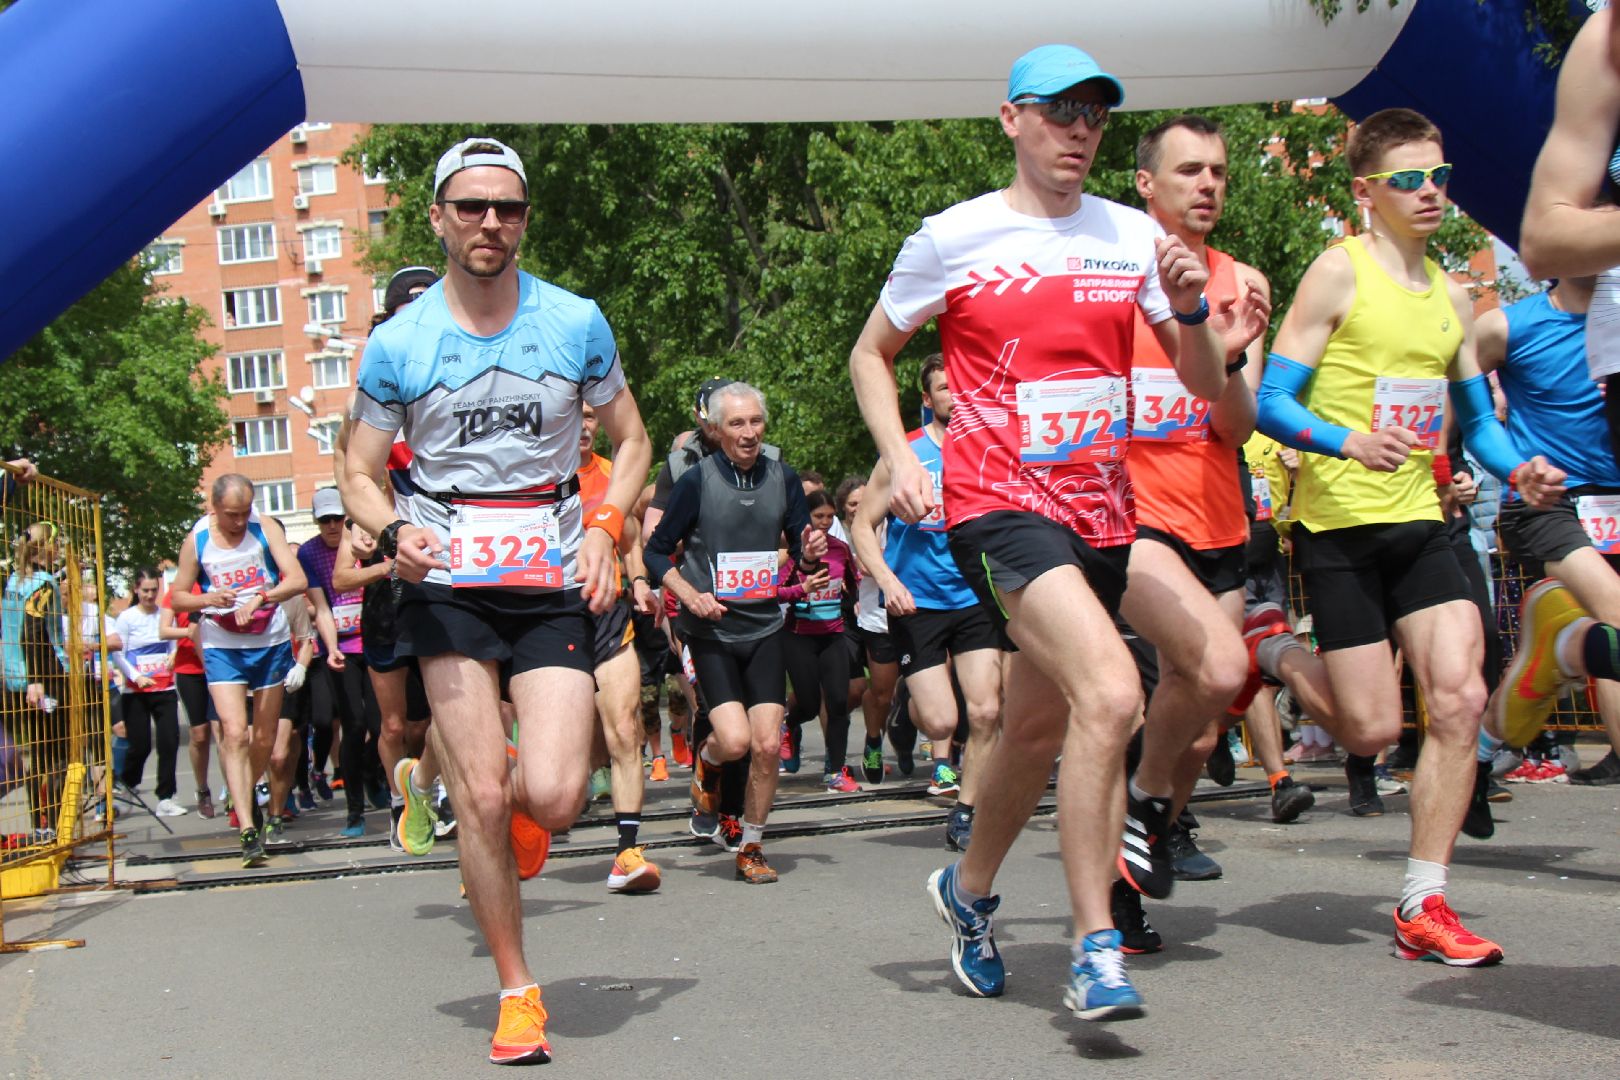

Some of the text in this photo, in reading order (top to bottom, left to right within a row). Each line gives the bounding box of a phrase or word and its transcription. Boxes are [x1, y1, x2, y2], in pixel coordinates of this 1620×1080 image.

[1083, 257, 1140, 271] ЛУКОЙЛ
[1073, 290, 1085, 303] В
[452, 401, 475, 410] TEAM
[477, 398, 488, 406] OF
[1142, 395, 1210, 427] 349
[453, 402, 543, 448] TOPSKI
[1041, 408, 1115, 446] 372
[1387, 404, 1438, 434] 327
[471, 535, 551, 568] 322
[223, 566, 257, 586] 389
[726, 569, 772, 589] 380
